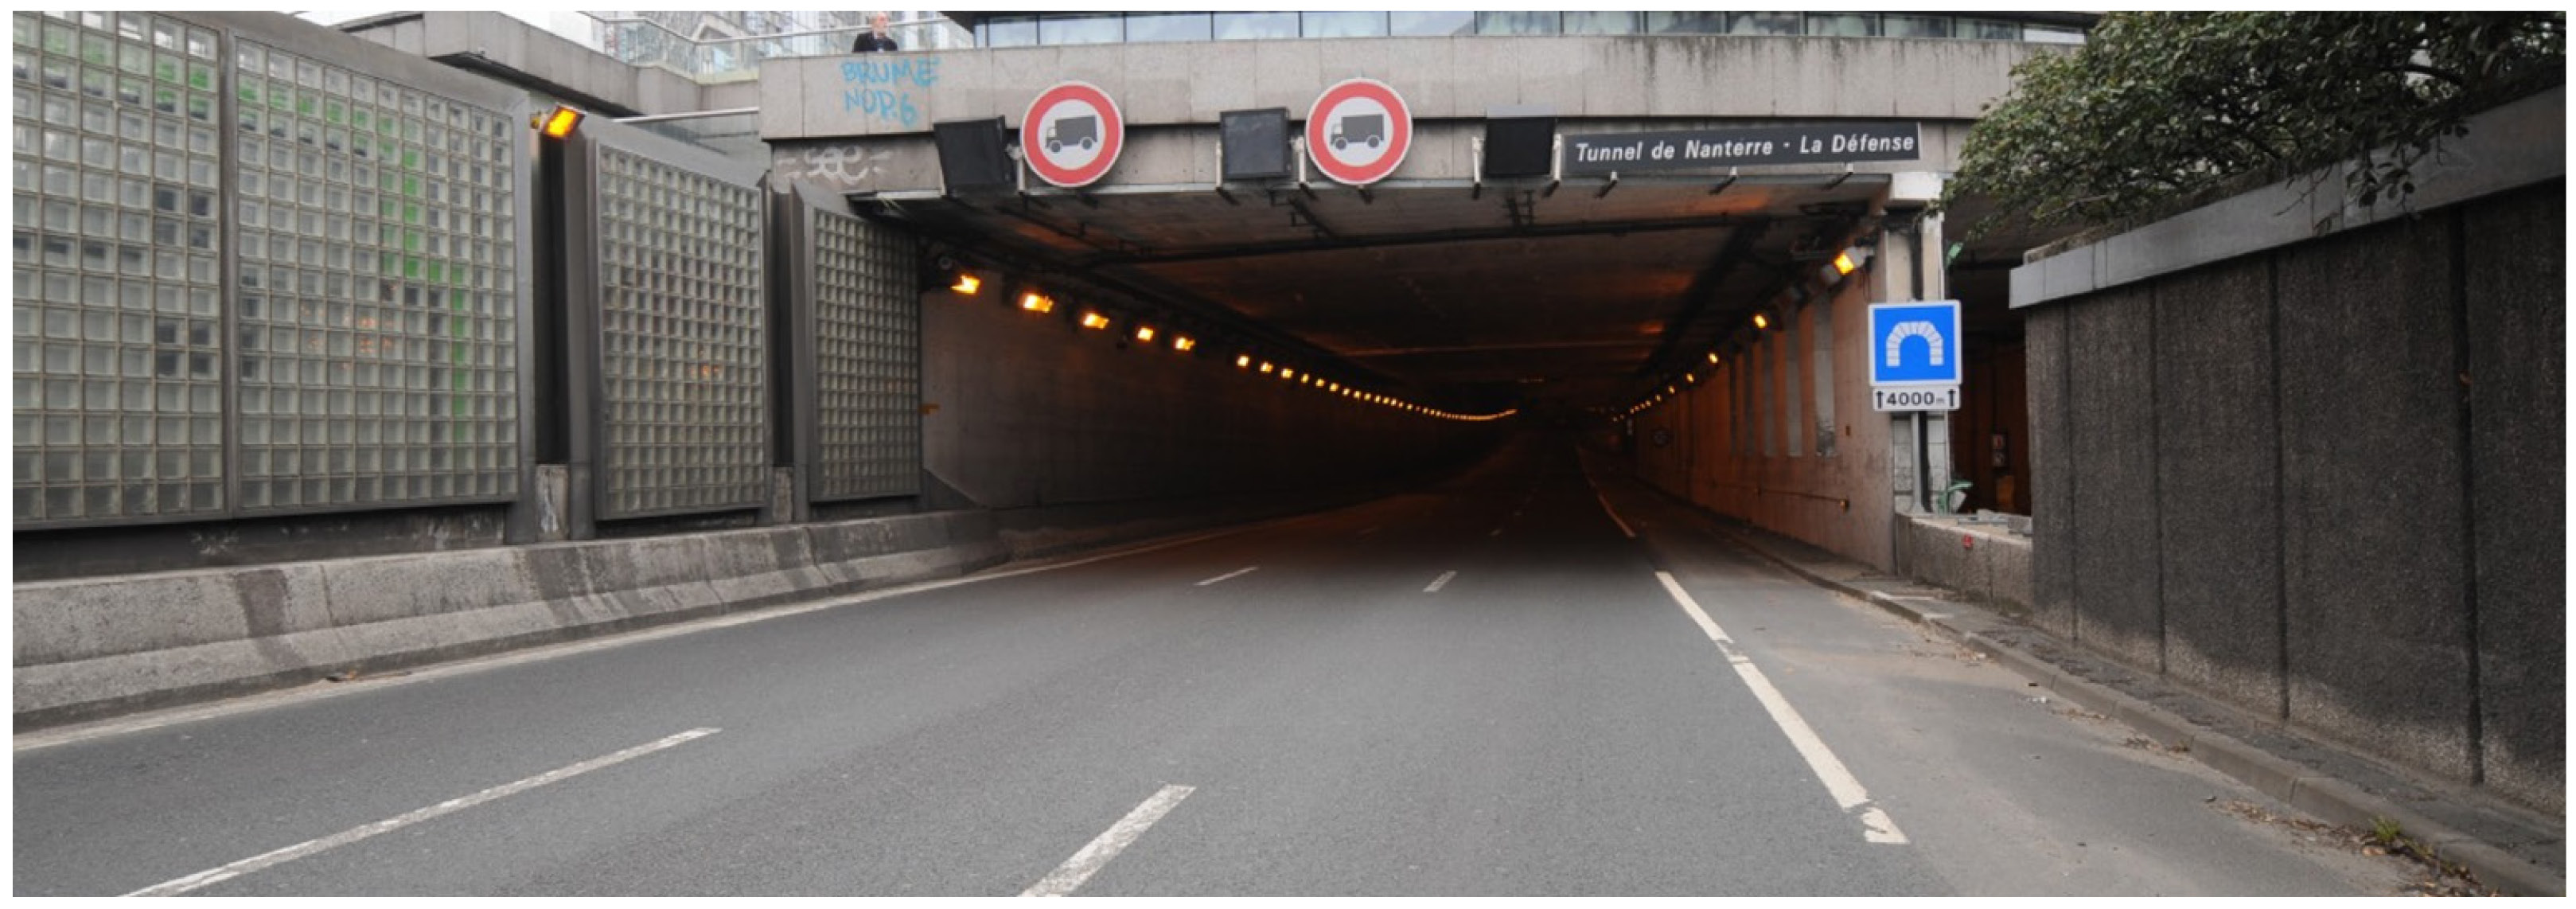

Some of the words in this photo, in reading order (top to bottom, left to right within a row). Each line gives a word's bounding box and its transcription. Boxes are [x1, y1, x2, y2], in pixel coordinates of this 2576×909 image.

[1575, 140, 1643, 162] Tunnel
[1650, 139, 1676, 160] de
[1684, 138, 1774, 159] Nanterre
[1799, 134, 1823, 154] La
[1831, 133, 1915, 154] Défense
